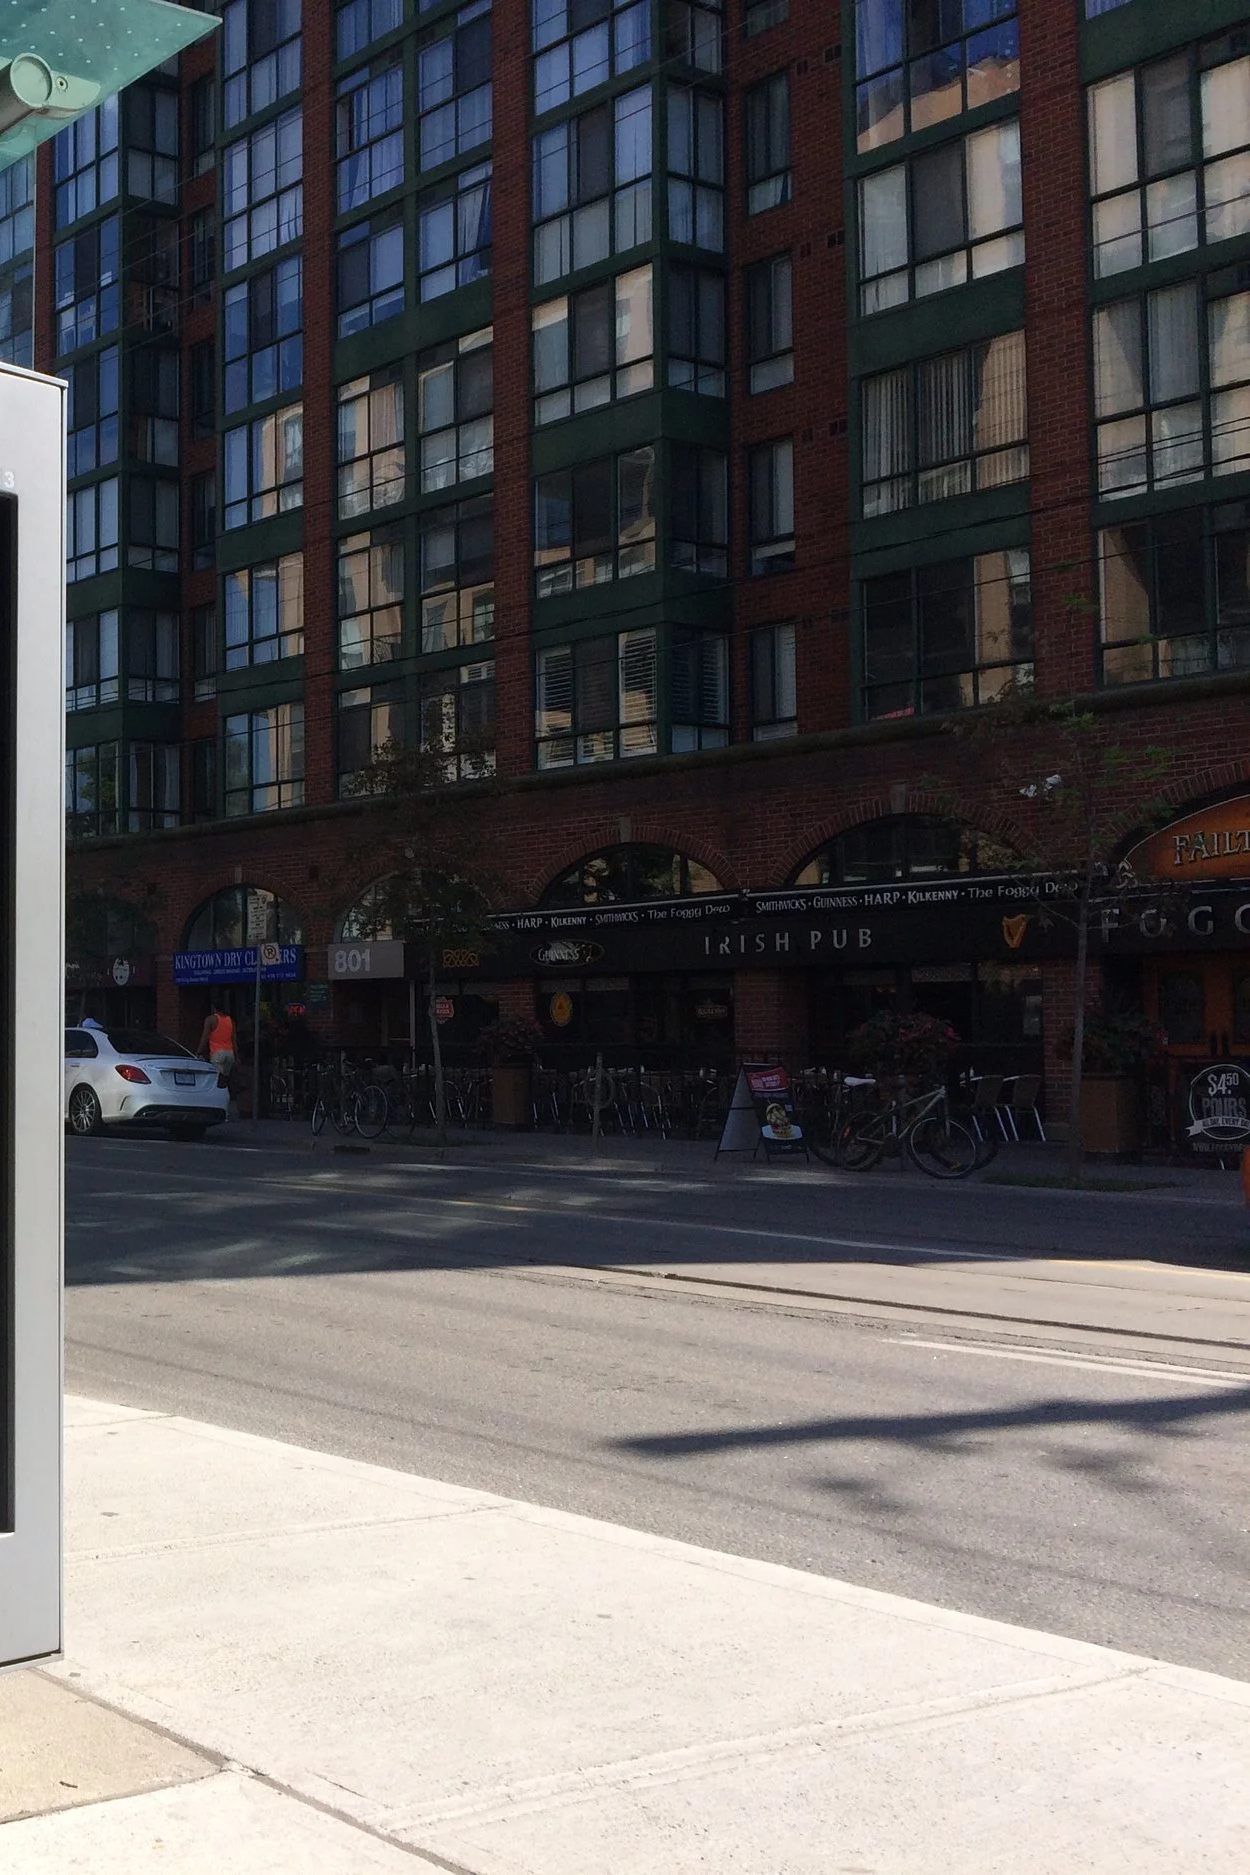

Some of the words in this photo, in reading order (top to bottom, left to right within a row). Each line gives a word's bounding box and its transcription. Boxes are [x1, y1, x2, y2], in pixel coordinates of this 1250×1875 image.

[812, 896, 858, 909] GUINNESS
[865, 892, 900, 906] HARP
[907, 889, 959, 905] KILKENNY
[968, 886, 992, 899] The
[517, 917, 543, 929] HARP
[551, 914, 587, 929] KILKENNY
[646, 908, 667, 919] The
[670, 907, 702, 919] Foggy
[704, 931, 790, 955] IRISH
[809, 927, 873, 950] PUB
[174, 952, 223, 970] KINGTOWN
[223, 951, 243, 968] DRY
[333, 948, 372, 973] 801
[537, 948, 580, 962] GUINNESS
